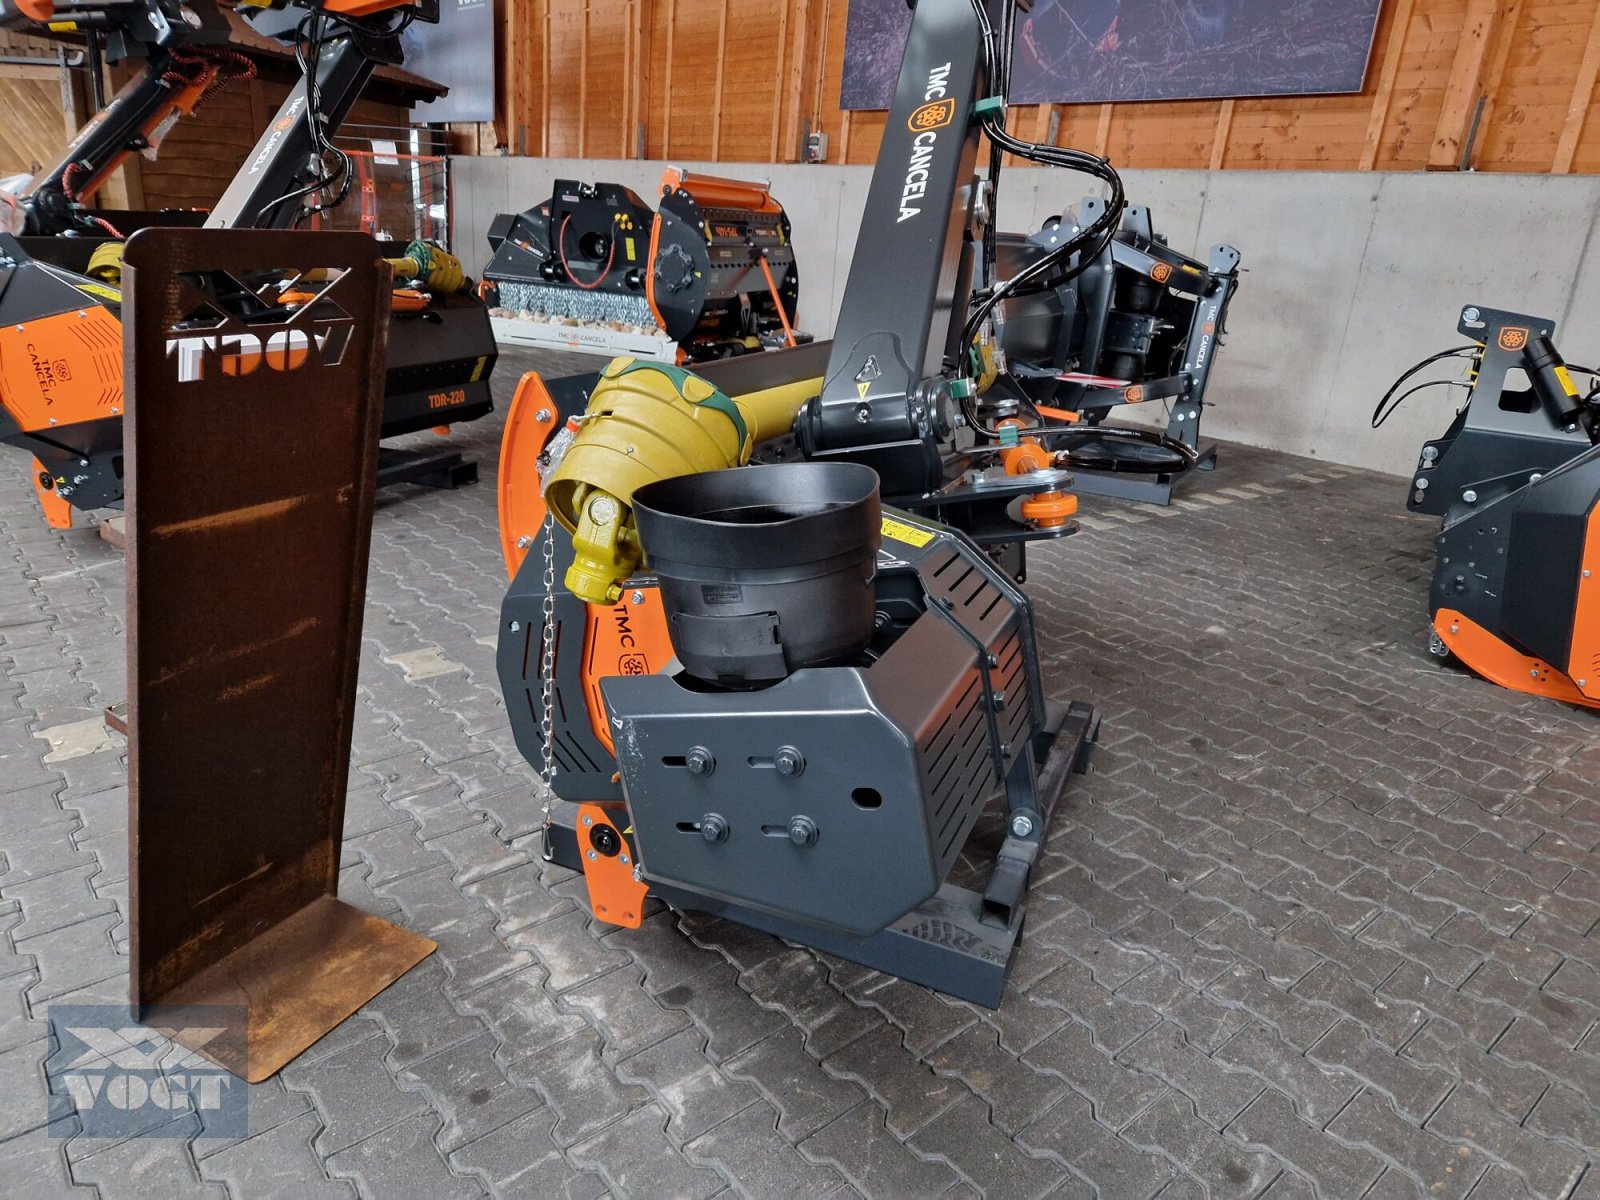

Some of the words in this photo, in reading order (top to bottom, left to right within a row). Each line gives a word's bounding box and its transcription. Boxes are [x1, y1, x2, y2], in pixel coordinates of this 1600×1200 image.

[924, 62, 952, 102] TMC
[286, 96, 304, 116] TMC
[248, 131, 281, 174] CANCELA
[896, 131, 937, 223] CANCELA
[1207, 304, 1217, 322] TMC
[580, 335, 607, 344] CANCELA
[1195, 334, 1209, 369] CANCELA
[26, 343, 54, 406] CANCELA
[41, 358, 57, 388] TMC
[428, 390, 465, 409] TDR-220
[614, 604, 635, 648] TMC
